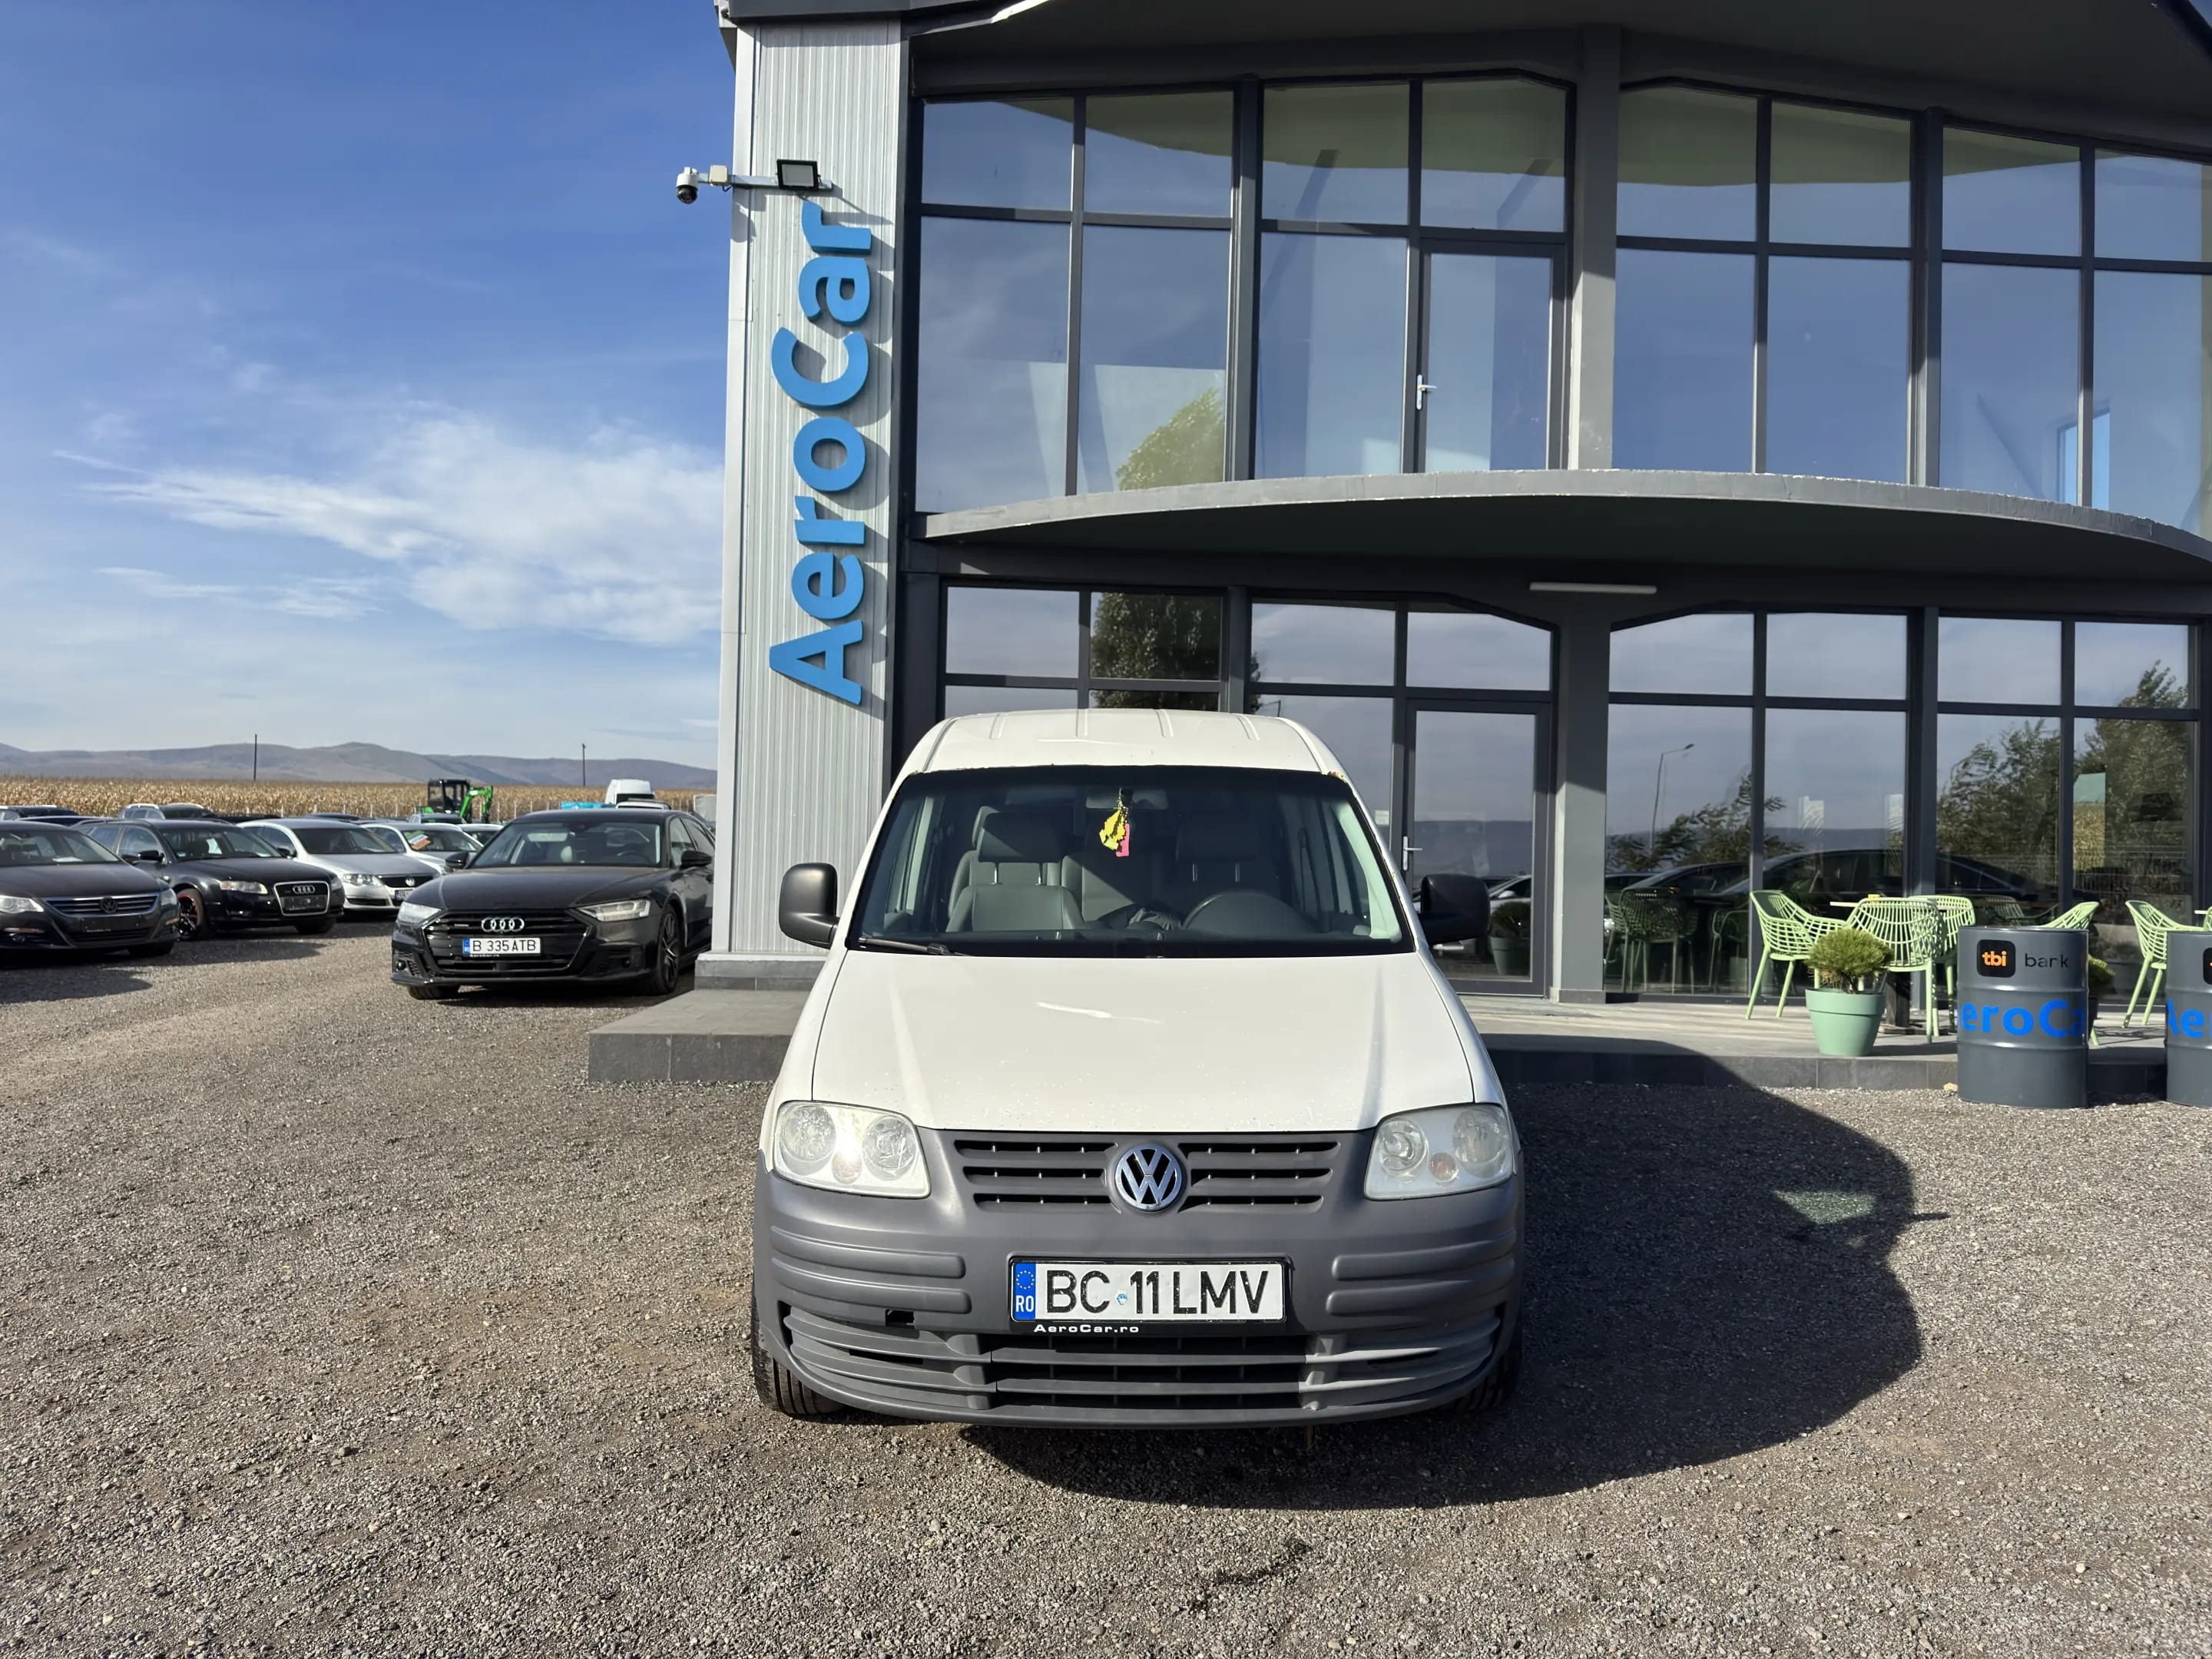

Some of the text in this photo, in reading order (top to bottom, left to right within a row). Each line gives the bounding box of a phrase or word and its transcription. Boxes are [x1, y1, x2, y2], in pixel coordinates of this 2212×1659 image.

[769, 202, 871, 706] AeroCar
[472, 940, 482, 952] B
[487, 940, 509, 952] 335
[512, 940, 536, 952] ATB
[1982, 951, 2007, 966] tbi
[1047, 1270, 1268, 1314] BC 11 LMV
[1015, 1295, 1034, 1313] RO
[1033, 1323, 1139, 1333] AeroCar.ro
